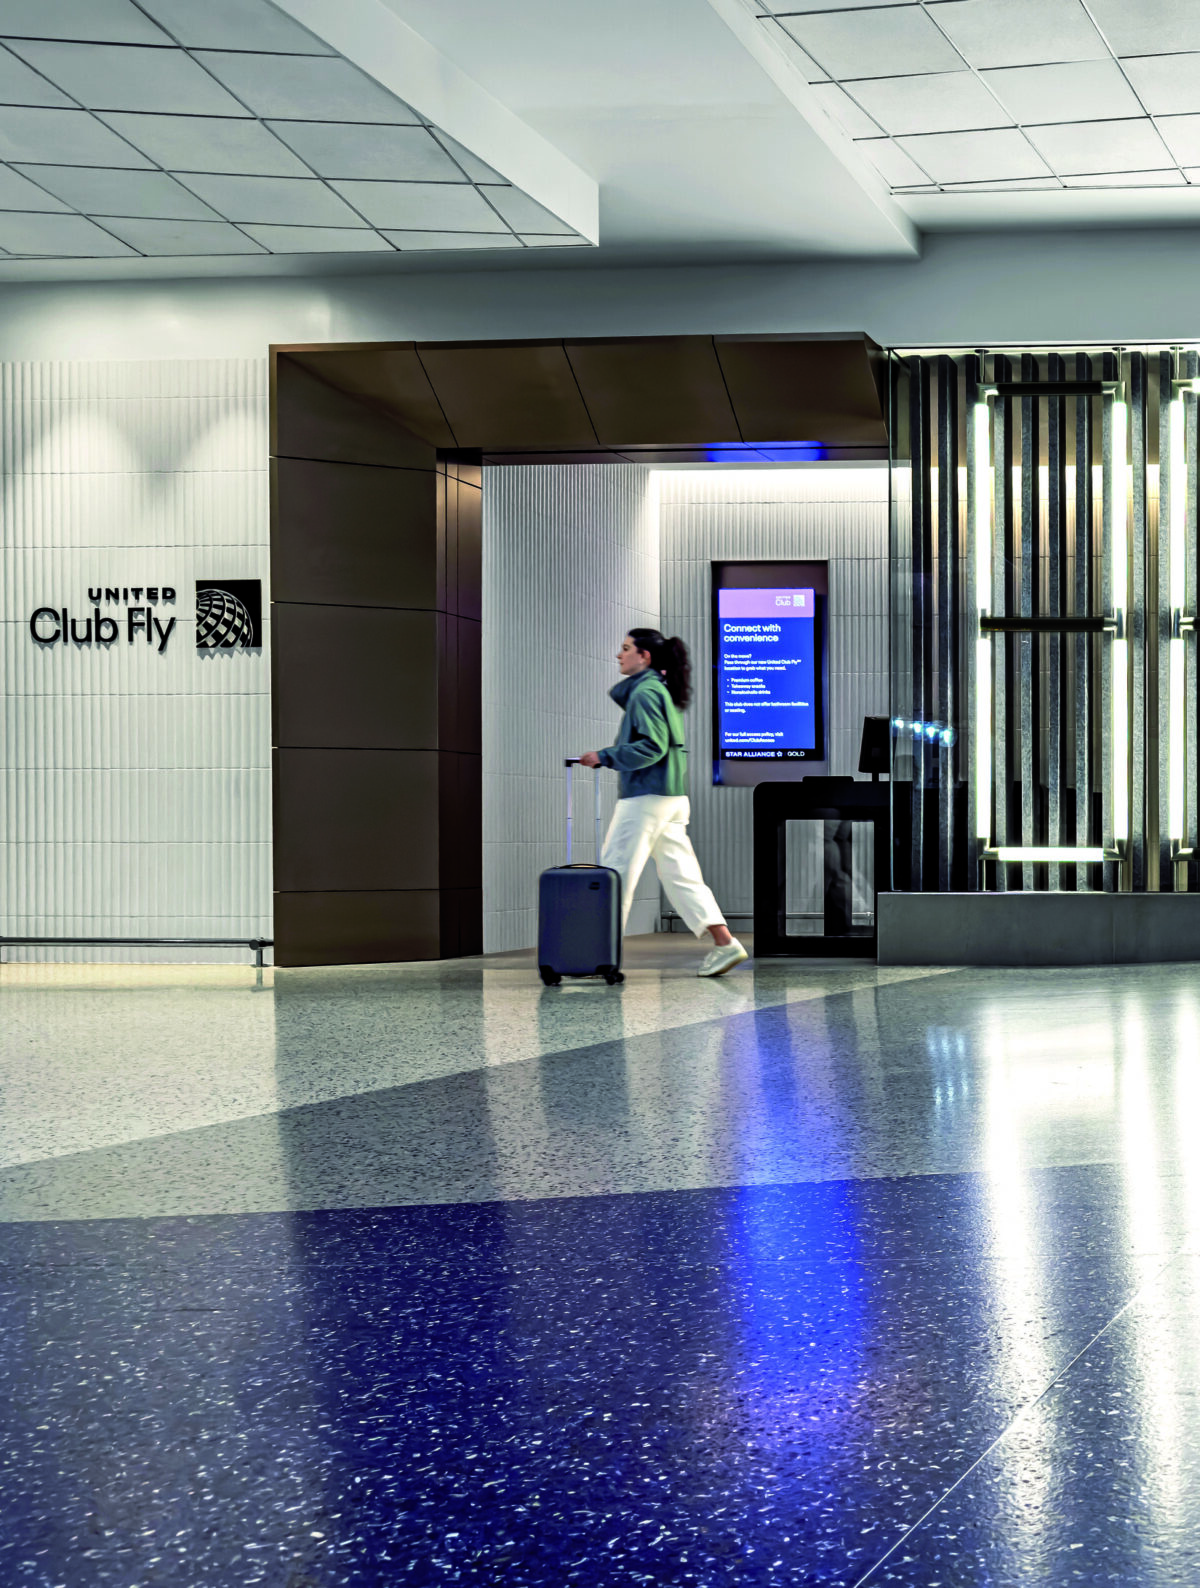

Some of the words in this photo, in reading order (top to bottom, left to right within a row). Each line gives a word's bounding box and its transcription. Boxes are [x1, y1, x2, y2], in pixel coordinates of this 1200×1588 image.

[88, 587, 176, 601] UNITED
[30, 607, 119, 643] Club
[127, 607, 176, 651] Fly
[723, 624, 761, 632] Connect
[762, 624, 781, 632] with
[724, 634, 779, 642] convenience
